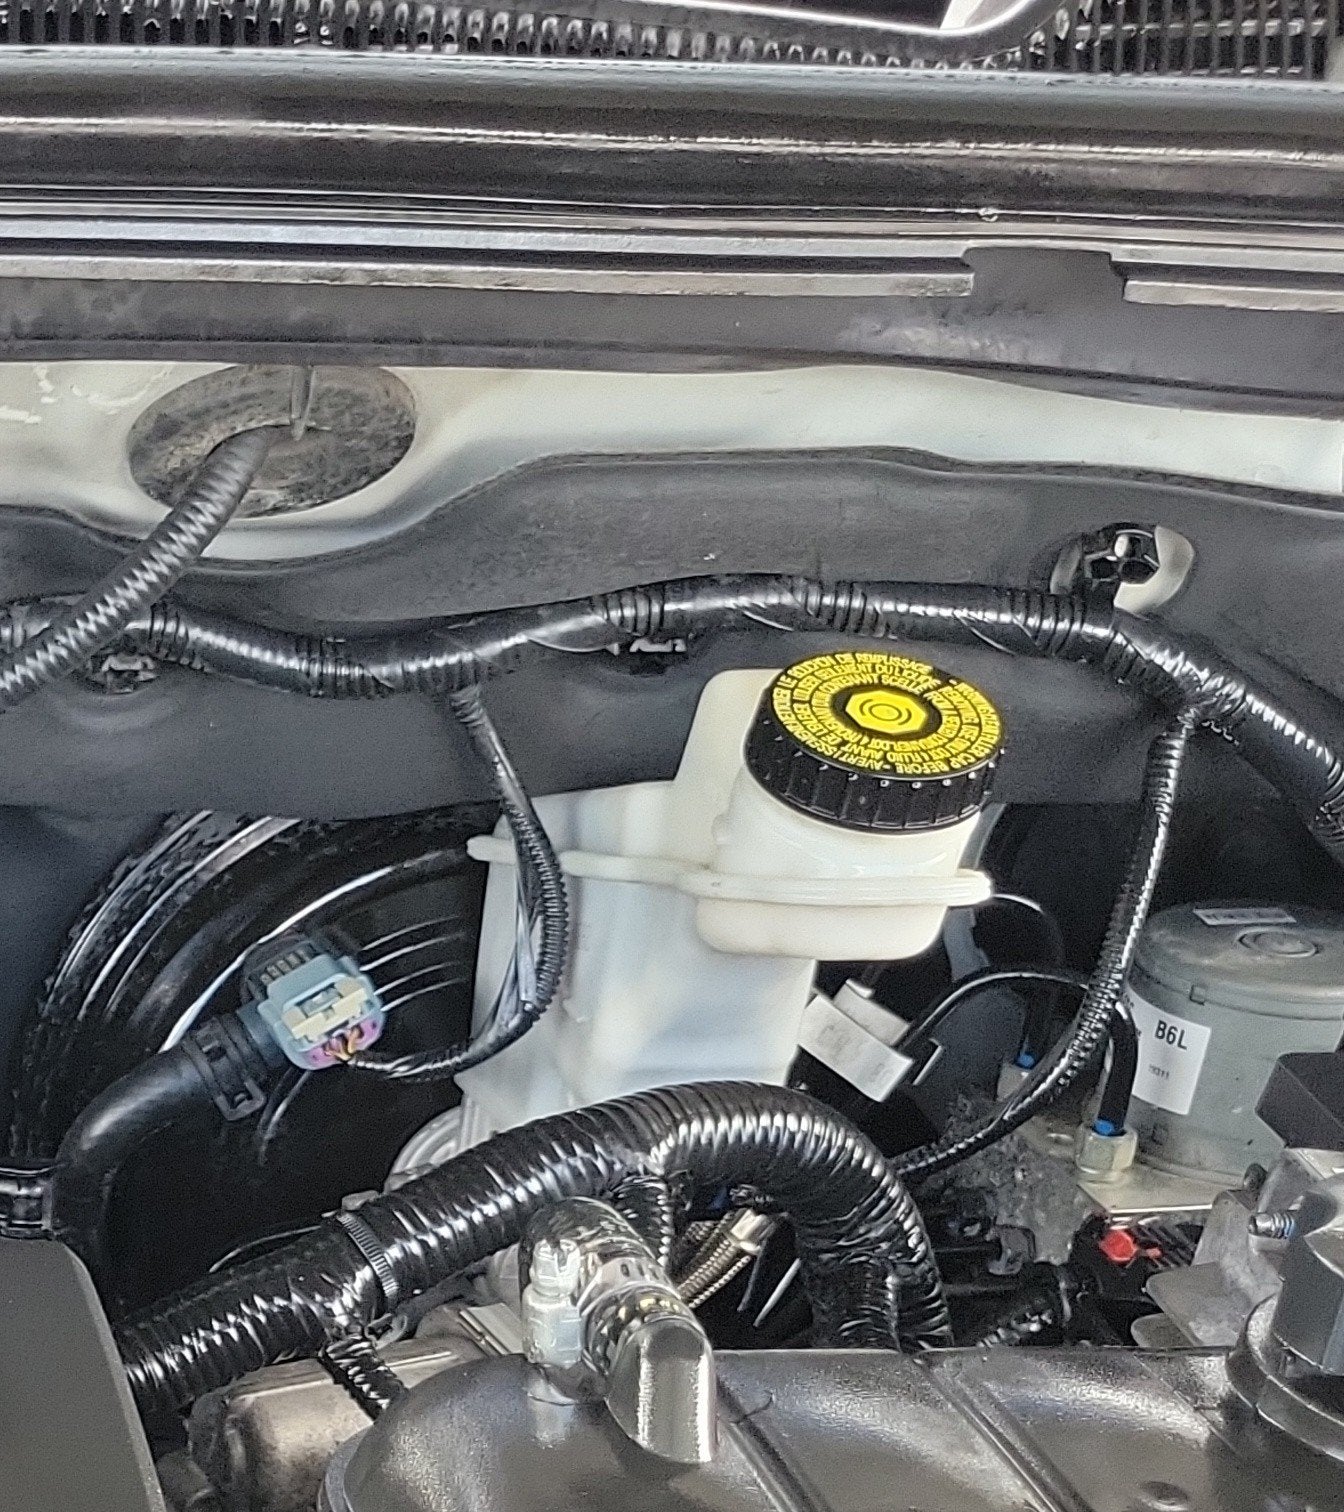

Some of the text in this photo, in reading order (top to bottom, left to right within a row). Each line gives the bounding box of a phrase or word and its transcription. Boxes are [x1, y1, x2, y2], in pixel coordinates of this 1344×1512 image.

[775, 674, 799, 688] LE
[838, 740, 883, 761] AVANT
[874, 663, 893, 675] DU
[957, 724, 979, 742] USE
[965, 731, 999, 758] FILLER
[886, 750, 924, 762] FLUID
[942, 751, 980, 769] CAP
[894, 760, 953, 773] BEFORE
[1154, 1019, 1188, 1051] B6L
